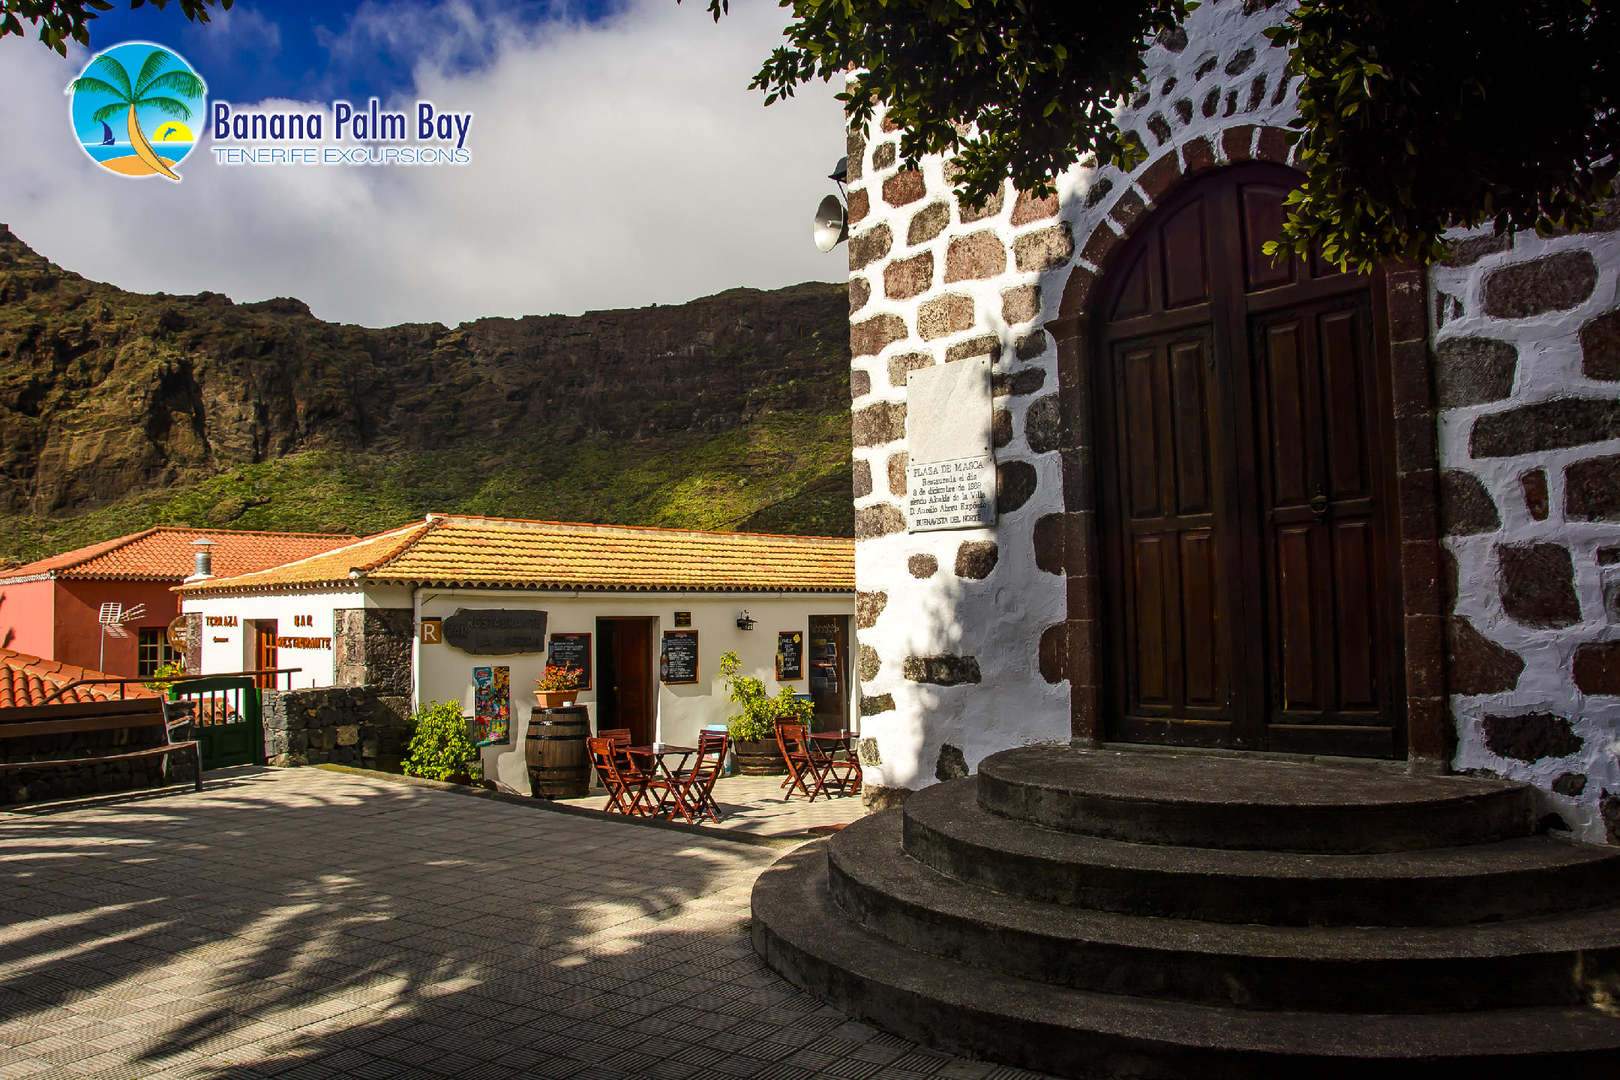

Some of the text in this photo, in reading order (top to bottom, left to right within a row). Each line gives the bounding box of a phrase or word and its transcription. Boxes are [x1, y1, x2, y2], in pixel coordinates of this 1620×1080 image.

[941, 465, 952, 473] DE
[955, 461, 984, 472] MASCA
[922, 476, 957, 487] Restaurada
[919, 488, 926, 496] de
[928, 485, 955, 495] diciembre
[294, 615, 314, 628] BAR
[424, 623, 437, 641] R
